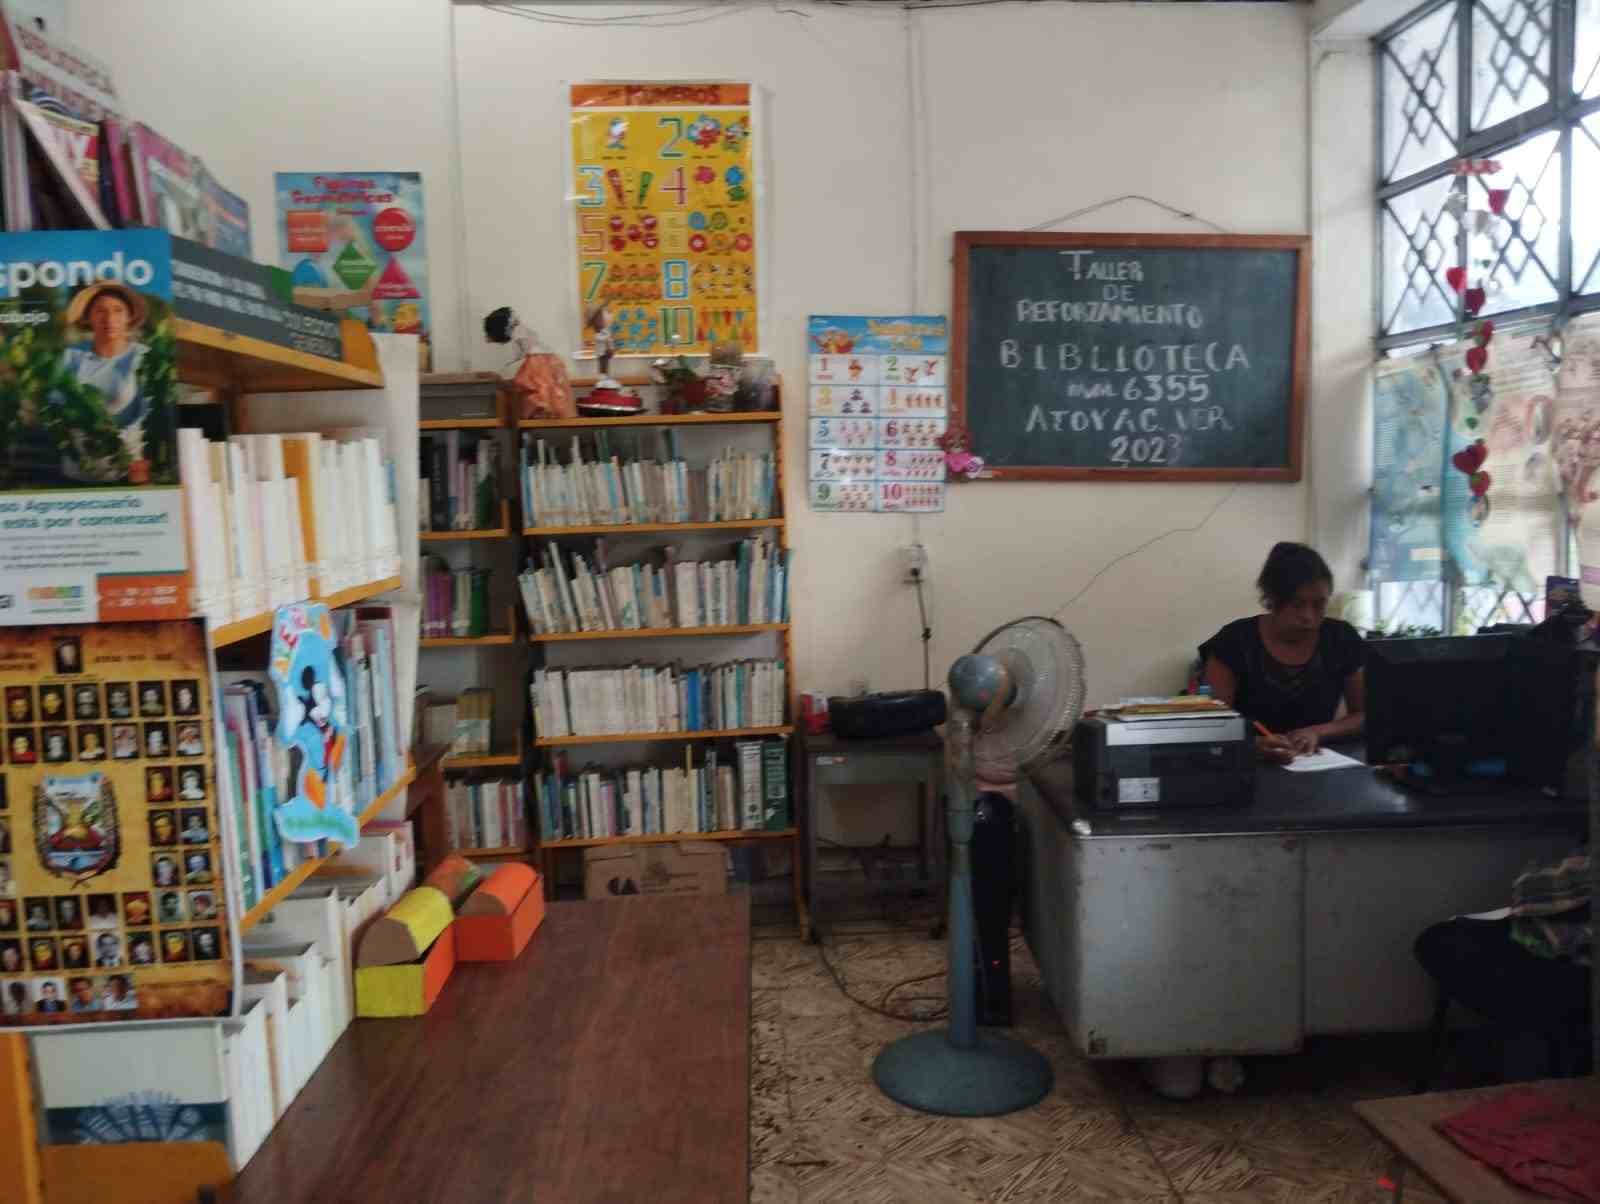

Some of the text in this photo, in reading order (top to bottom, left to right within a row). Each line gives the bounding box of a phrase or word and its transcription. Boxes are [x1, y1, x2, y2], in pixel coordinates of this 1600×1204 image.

[657, 116, 685, 160] 2
[659, 165, 690, 206] 4
[581, 258, 608, 303] 7
[662, 258, 690, 301] 8
[1058, 249, 1145, 282] TALLER
[1103, 283, 1135, 303] DE
[1016, 299, 1204, 329] REFORZAMIENTO
[1000, 339, 1250, 372] BIBLIOTECA
[1122, 374, 1211, 402] 6355
[882, 483, 902, 500] 10
